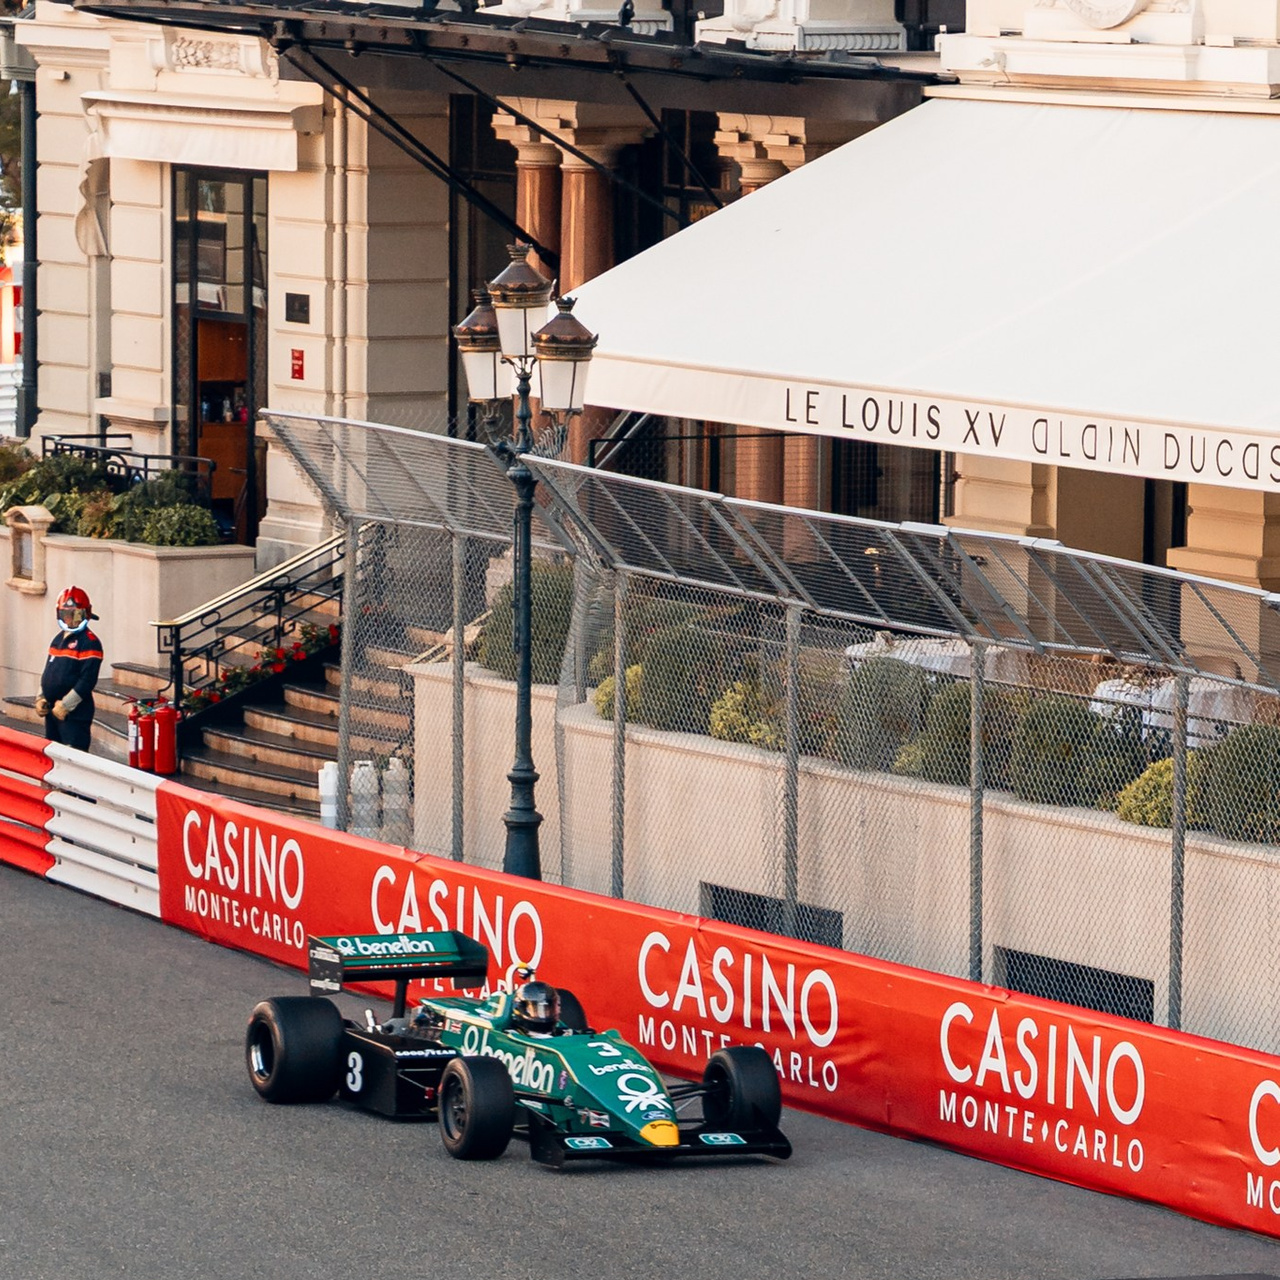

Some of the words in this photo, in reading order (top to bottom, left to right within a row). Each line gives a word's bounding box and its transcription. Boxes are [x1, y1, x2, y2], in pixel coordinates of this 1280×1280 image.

[786, 388, 819, 425] LE
[842, 394, 941, 440] LOUIS
[962, 409, 1006, 447] XV
[1032, 418, 1141, 466] ALAIN
[182, 809, 304, 910] CASINO
[370, 864, 543, 971] CASINO
[354, 935, 435, 955] benetton
[637, 931, 838, 1048] CASINO
[346, 1051, 363, 1093] 3
[395, 1048, 457, 1057] GOODYEAR
[587, 1041, 622, 1057] 3
[588, 1058, 654, 1076] benetton
[753, 1042, 838, 1092] ARLO
[939, 1001, 1145, 1126] CASINO
